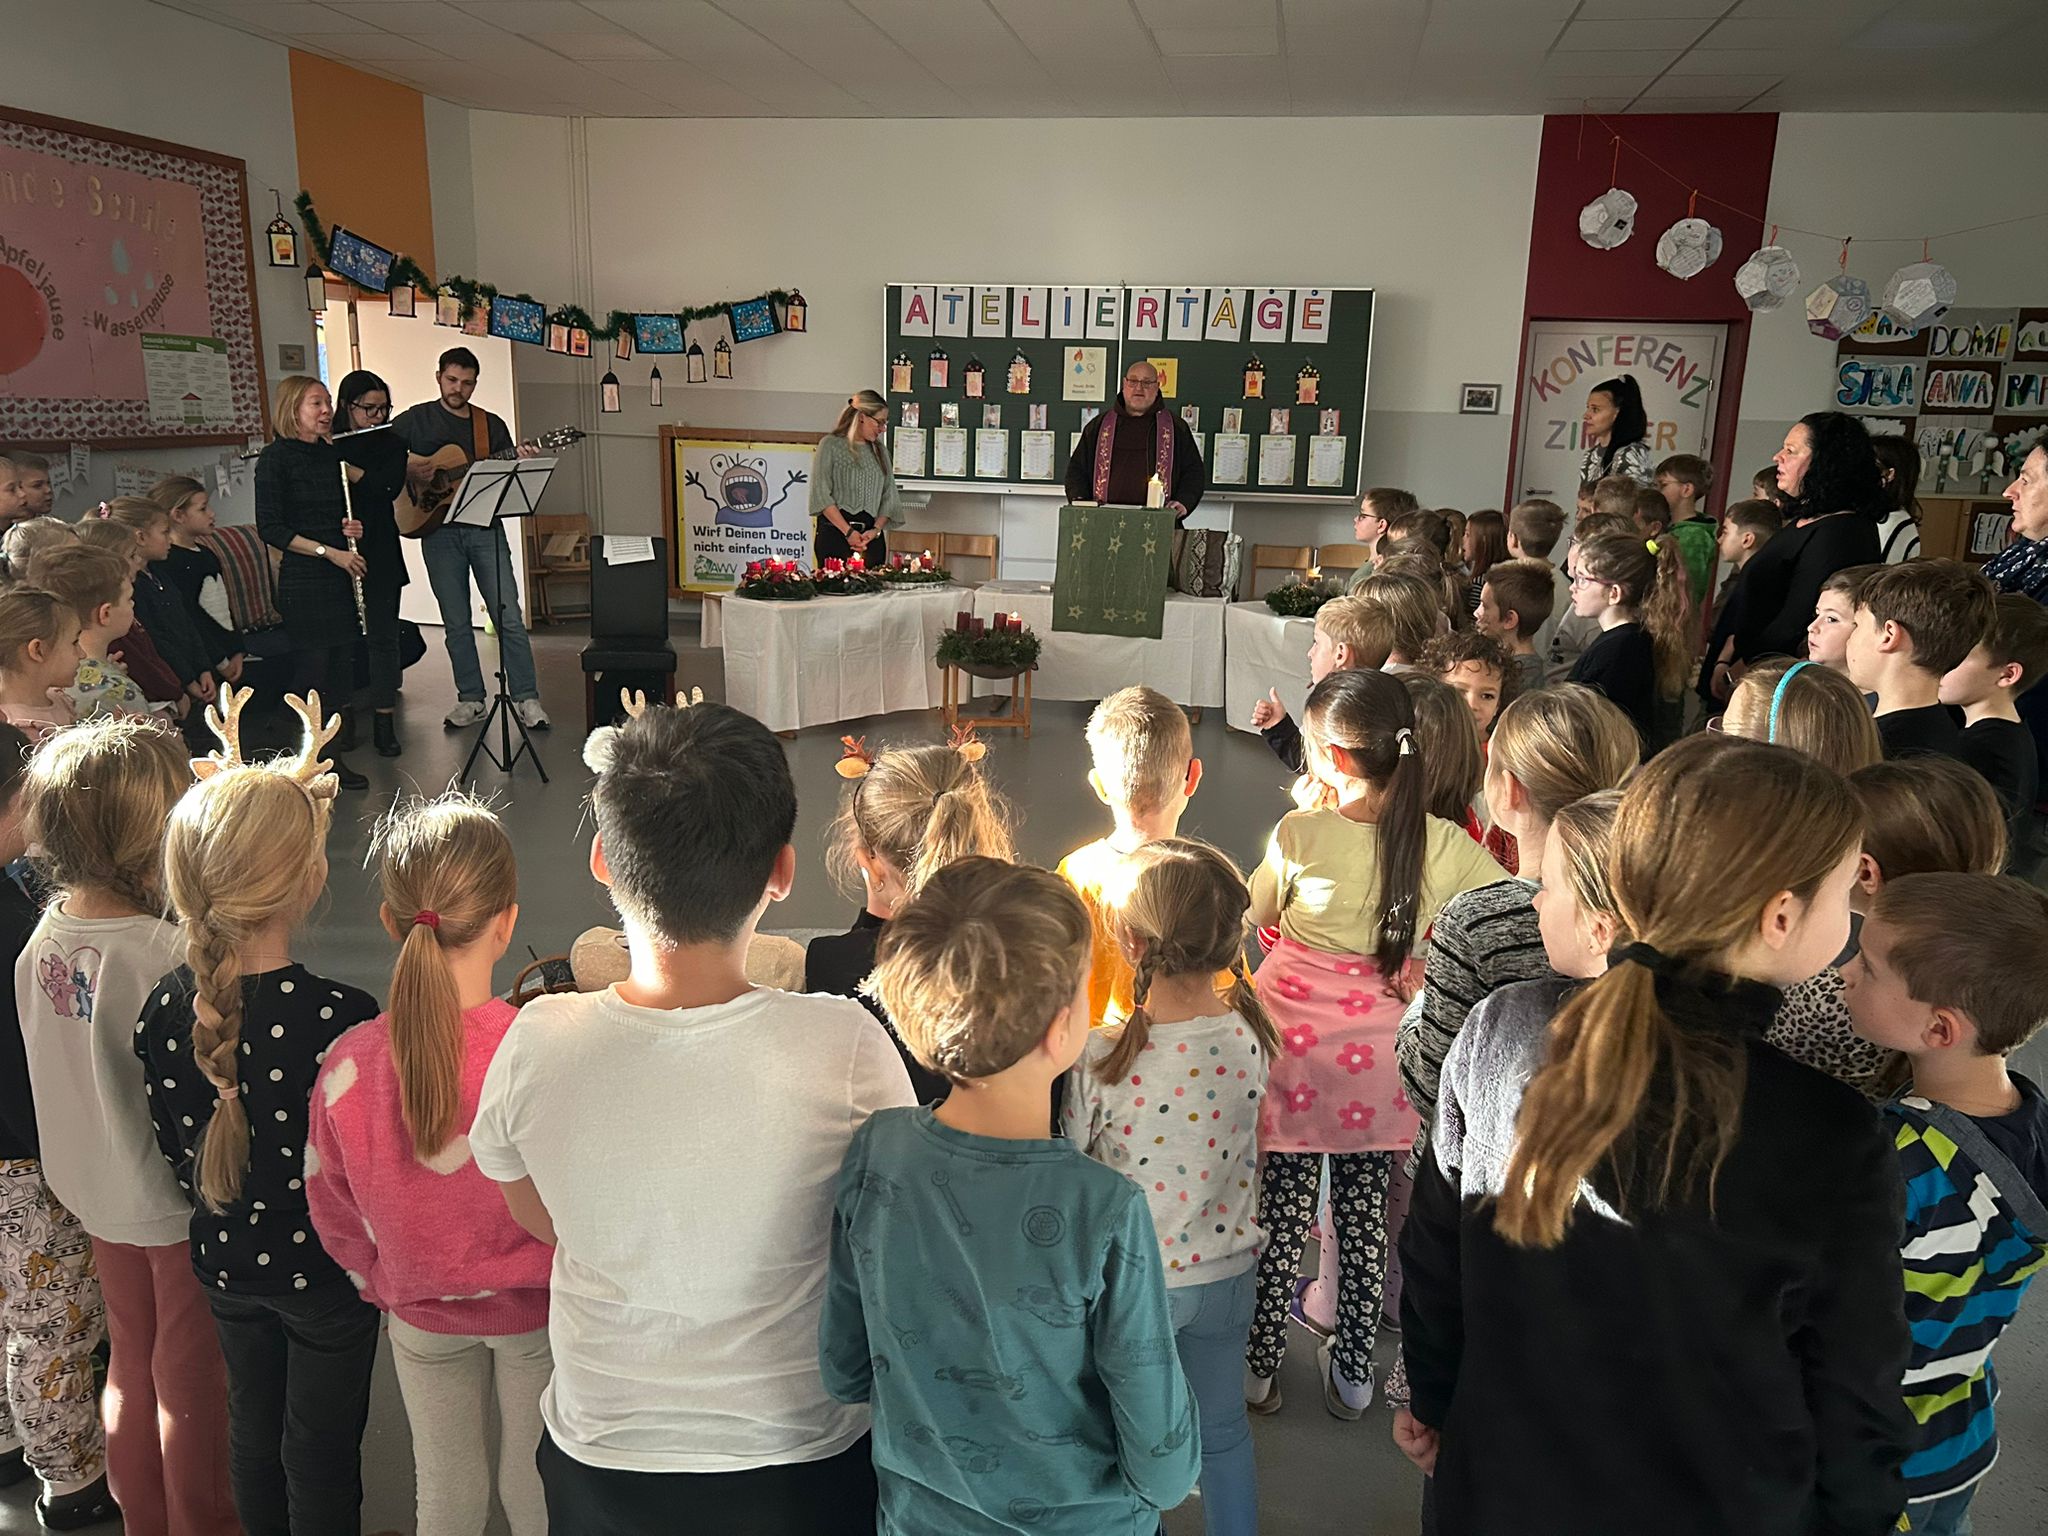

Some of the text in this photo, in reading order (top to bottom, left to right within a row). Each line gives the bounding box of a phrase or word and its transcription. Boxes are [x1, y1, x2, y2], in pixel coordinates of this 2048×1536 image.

[94, 272, 175, 338] Wasserpause
[905, 294, 1324, 330] ATELIERTAGE
[1930, 324, 2011, 356] DOMI
[1530, 335, 1712, 409] KONFERENZ
[1927, 371, 1988, 405] ANNA
[693, 526, 807, 541] Wirf Deinen Dreck
[694, 541, 805, 558] nicht einfach weg!
[710, 562, 738, 574] AWV
